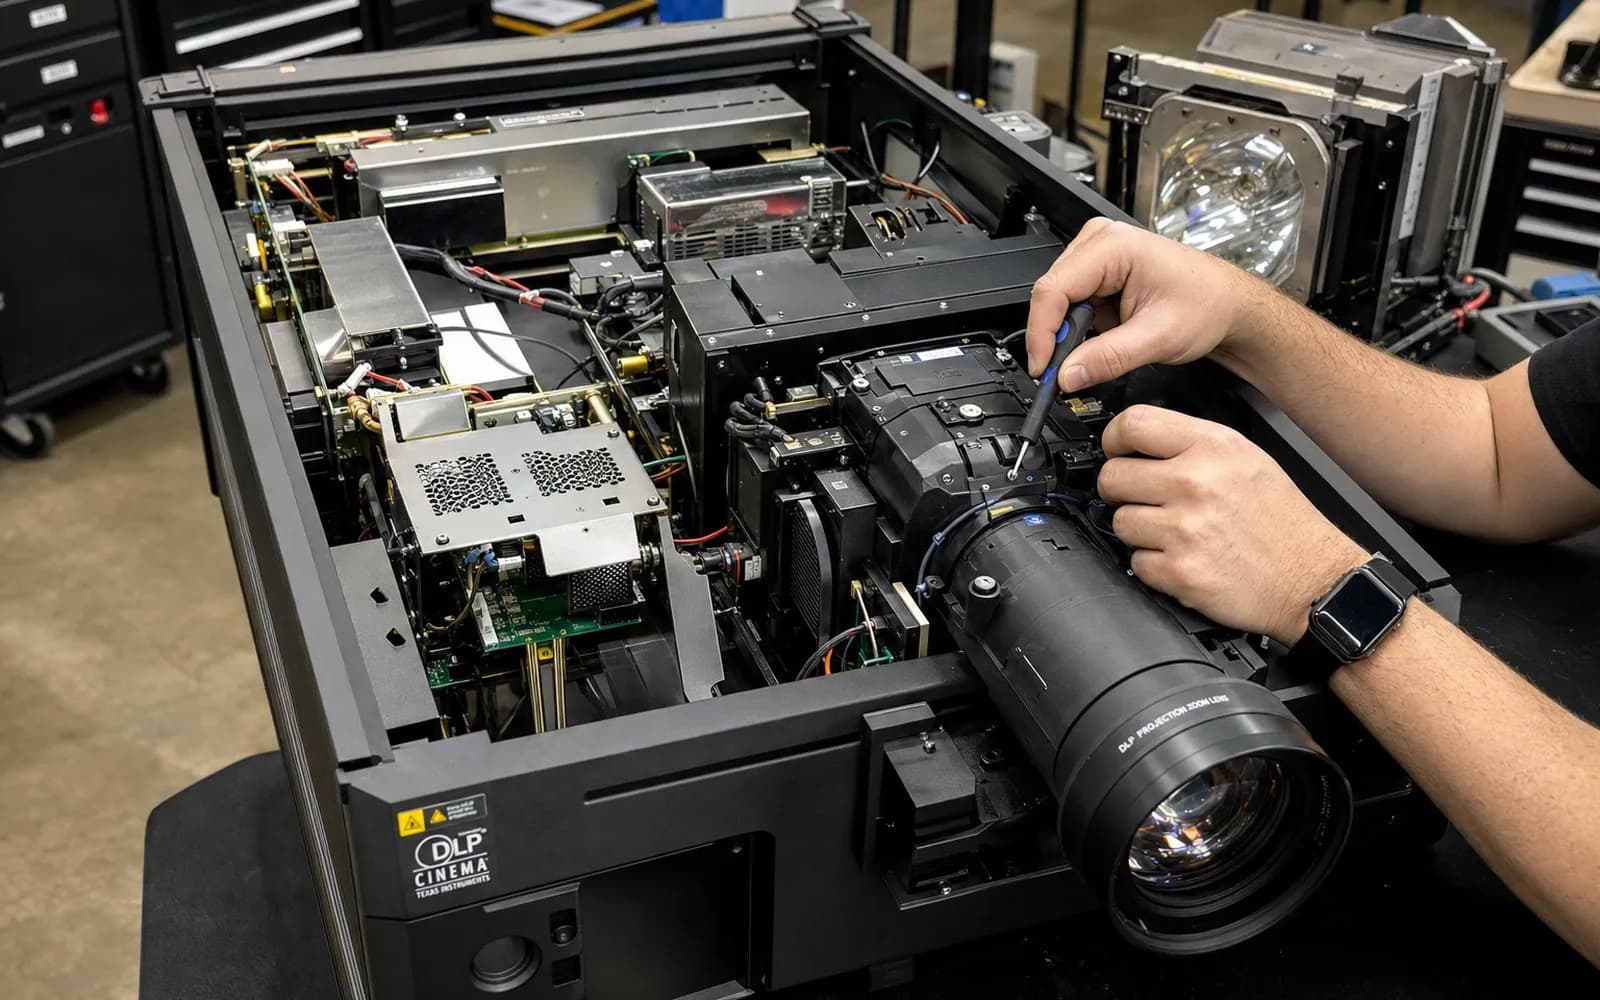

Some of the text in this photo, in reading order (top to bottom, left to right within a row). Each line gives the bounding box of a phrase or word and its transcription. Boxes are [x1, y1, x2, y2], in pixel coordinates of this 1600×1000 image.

[1118, 694, 1230, 753] DLP PROJECTION ZOOM LENS
[431, 833, 483, 862] DLP
[414, 858, 488, 888] CINEMA
[416, 874, 491, 899] TEXAS INSTRUMENTS
